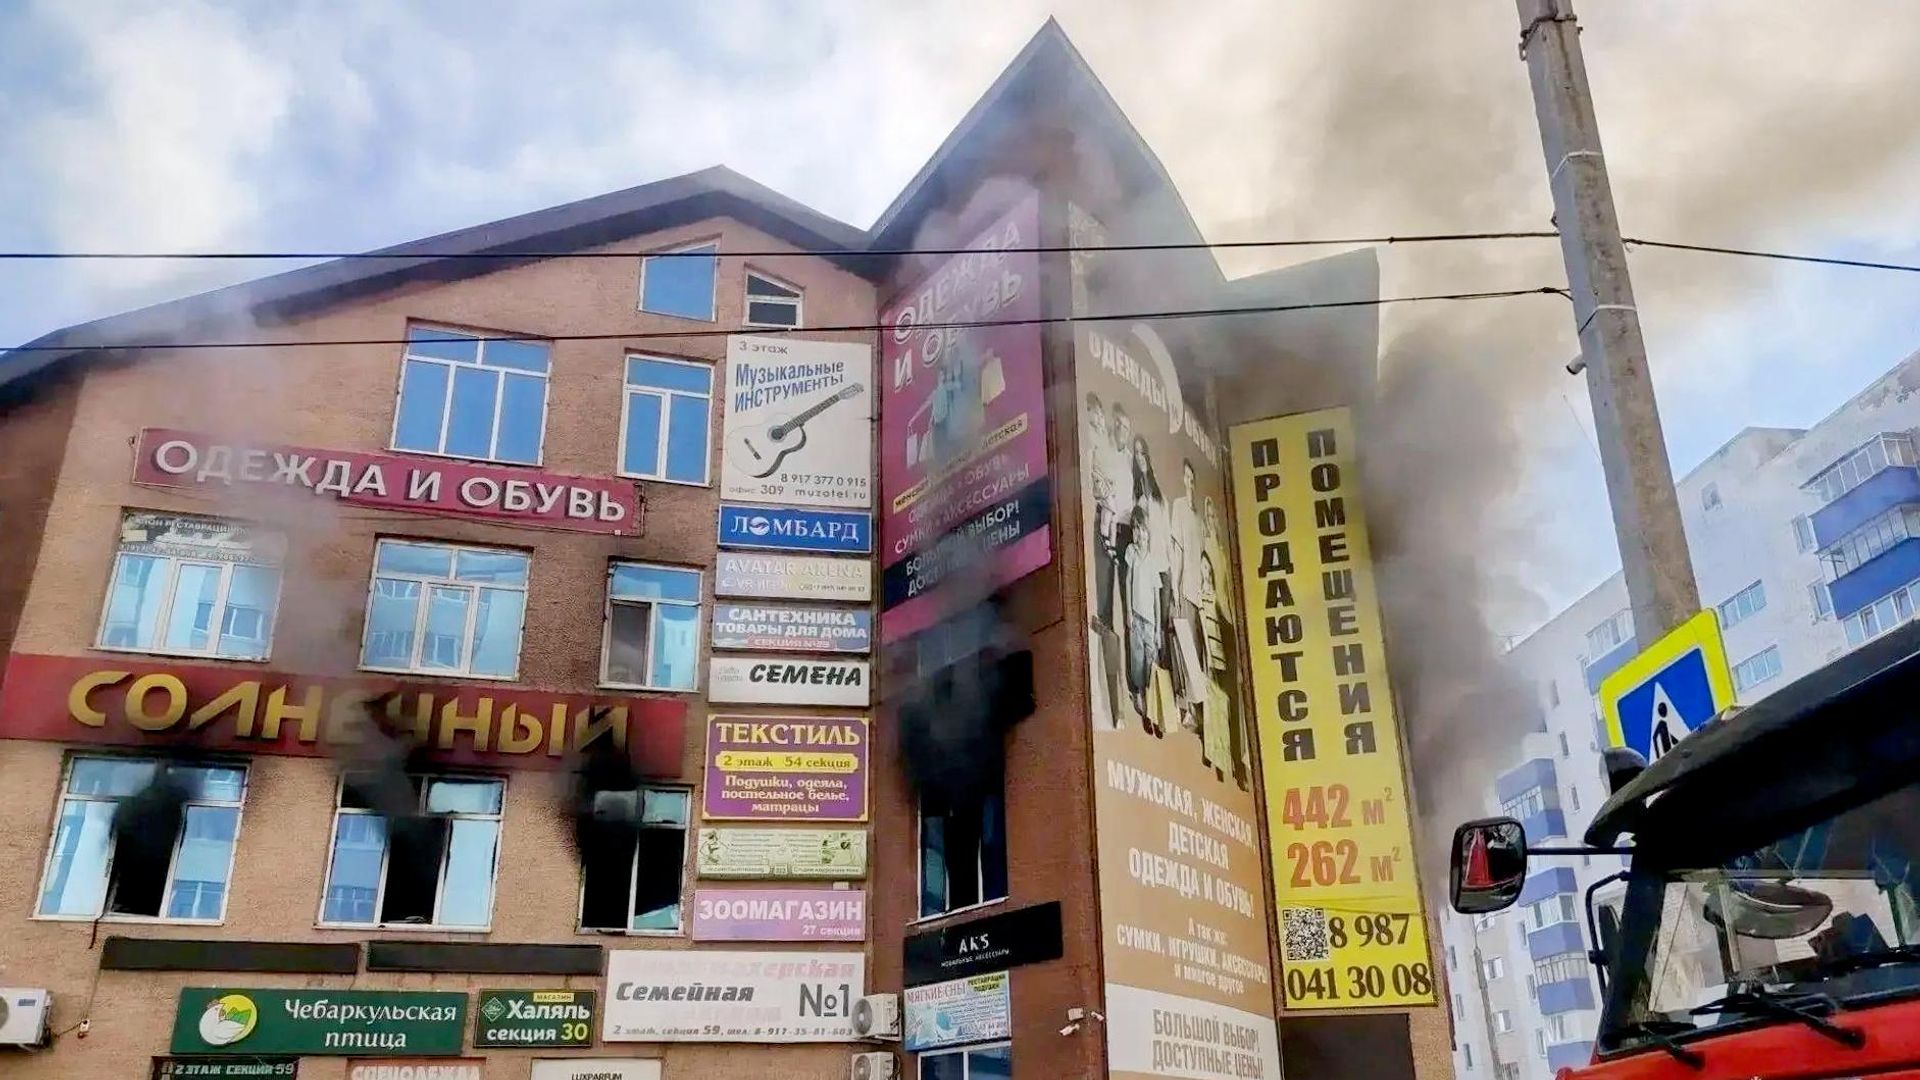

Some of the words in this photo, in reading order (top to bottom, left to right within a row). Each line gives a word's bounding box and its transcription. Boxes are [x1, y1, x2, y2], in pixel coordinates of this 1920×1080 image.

[739, 340, 747, 351] 3
[751, 343, 788, 354] этаж
[736, 361, 844, 390] Музыкальные
[734, 374, 844, 413] ИНСТРУМЕНТЫ
[156, 440, 387, 497] ОДЕЖДА
[409, 469, 442, 501] И
[461, 477, 626, 521] ОБУВЬ
[760, 485, 784, 495] 309
[780, 473, 788, 483] 8
[791, 475, 811, 484] 917
[814, 476, 834, 485] 377
[836, 477, 844, 487] 0
[847, 477, 867, 487] 915
[731, 515, 860, 543] ЛОМБАРД
[1251, 437, 1316, 762] ПРОДАЮТСЯ
[1307, 427, 1377, 755] ПОМЕЩЕНИЯ
[728, 608, 857, 626] САНТЕХНИКА
[715, 622, 782, 636] ТОВАРЫ
[784, 625, 818, 638] ДЛЯ
[820, 627, 868, 639] ДОМА
[749, 664, 861, 686] СЕМЕНА
[716, 722, 861, 746] ТЕКСТИЛЬ
[724, 755, 732, 766] 2
[737, 757, 774, 768] этаж
[784, 758, 802, 768] 54
[806, 759, 851, 770] секция
[722, 788, 805, 801] постельное
[725, 775, 793, 790] Подушки,
[797, 779, 848, 791] одеяла,
[752, 803, 820, 815] матрацы
[1107, 760, 1198, 823] МУЖСКАЯ,
[1202, 797, 1256, 854] ЖЕНСКАЯ,
[1283, 784, 1353, 831] 442
[1168, 821, 1230, 871] ДЕТСКАЯ
[1129, 847, 1200, 899] ОДЕЖДА
[1203, 872, 1213, 902] И
[1287, 839, 1361, 888] 262
[700, 900, 861, 921] ЗООМАГАЗИН
[802, 925, 817, 936] 27
[820, 926, 861, 937] секция
[1117, 924, 1165, 958] СУМКИ,
[1328, 916, 1348, 949] 8
[1355, 913, 1410, 948] 987
[959, 933, 990, 954] AKS
[906, 984, 945, 1003] МЯГКИЕ
[945, 980, 967, 999] СНЫ
[1287, 968, 1340, 1001] 041
[1348, 965, 1385, 999] 30
[1392, 962, 1432, 997] 08
[506, 999, 591, 1020] Халяль
[616, 981, 755, 1001] Семейная
[798, 983, 850, 1018] №1
[285, 999, 457, 1025] Чебаркульская
[325, 1031, 407, 1050] птица
[486, 1028, 557, 1043] секция
[561, 1022, 588, 1041] 30
[613, 1025, 621, 1035] 2
[1152, 1008, 1221, 1045] БОЛЬШОЙ
[1223, 1022, 1260, 1053] ВЫБОР!
[175, 1065, 184, 1075] 2
[185, 1065, 221, 1075] ЭТАЖ
[225, 1065, 273, 1076] СЕКЦИЯ
[274, 1064, 295, 1075] 59
[1152, 1040, 1232, 1076] ДОСТУПНЫЕ
[1234, 1053, 1264, 1080] ЦЕНЫ!
